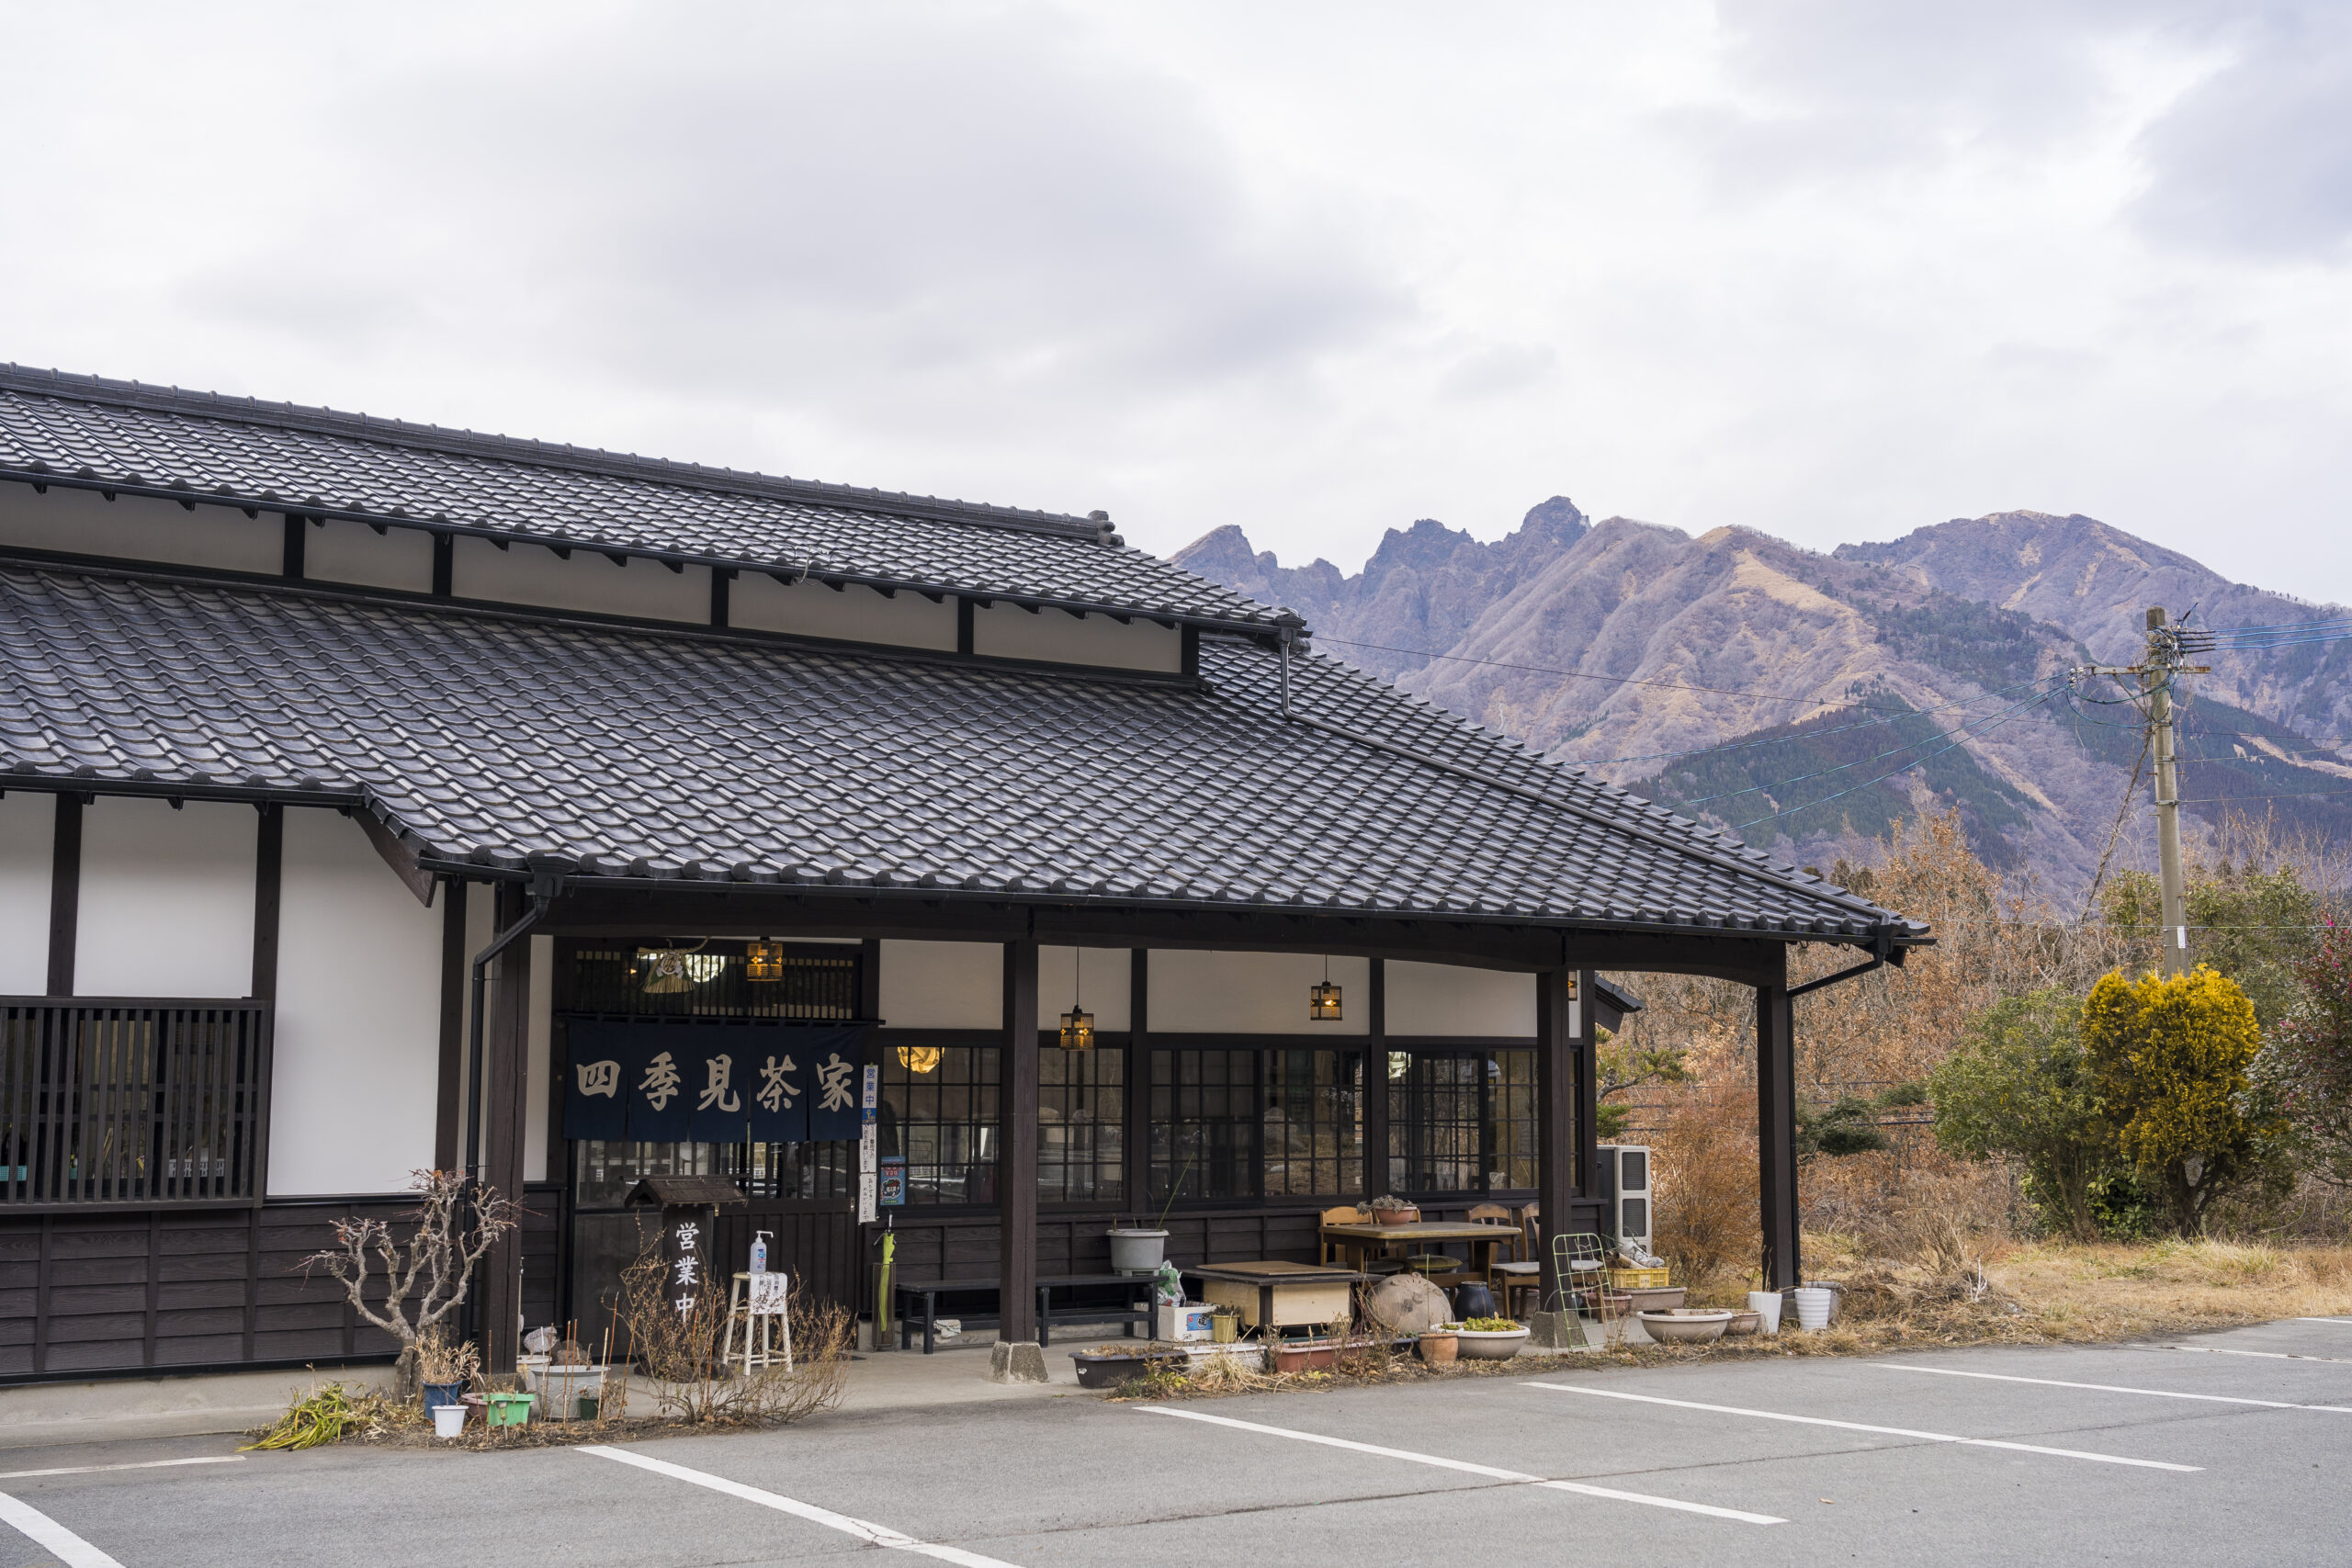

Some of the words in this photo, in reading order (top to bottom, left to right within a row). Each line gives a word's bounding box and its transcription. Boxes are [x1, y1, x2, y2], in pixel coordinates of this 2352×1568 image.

[575, 1051, 854, 1112] 四季見茶家
[865, 1067, 876, 1106] 営業中
[674, 1222, 700, 1323] 営業中
